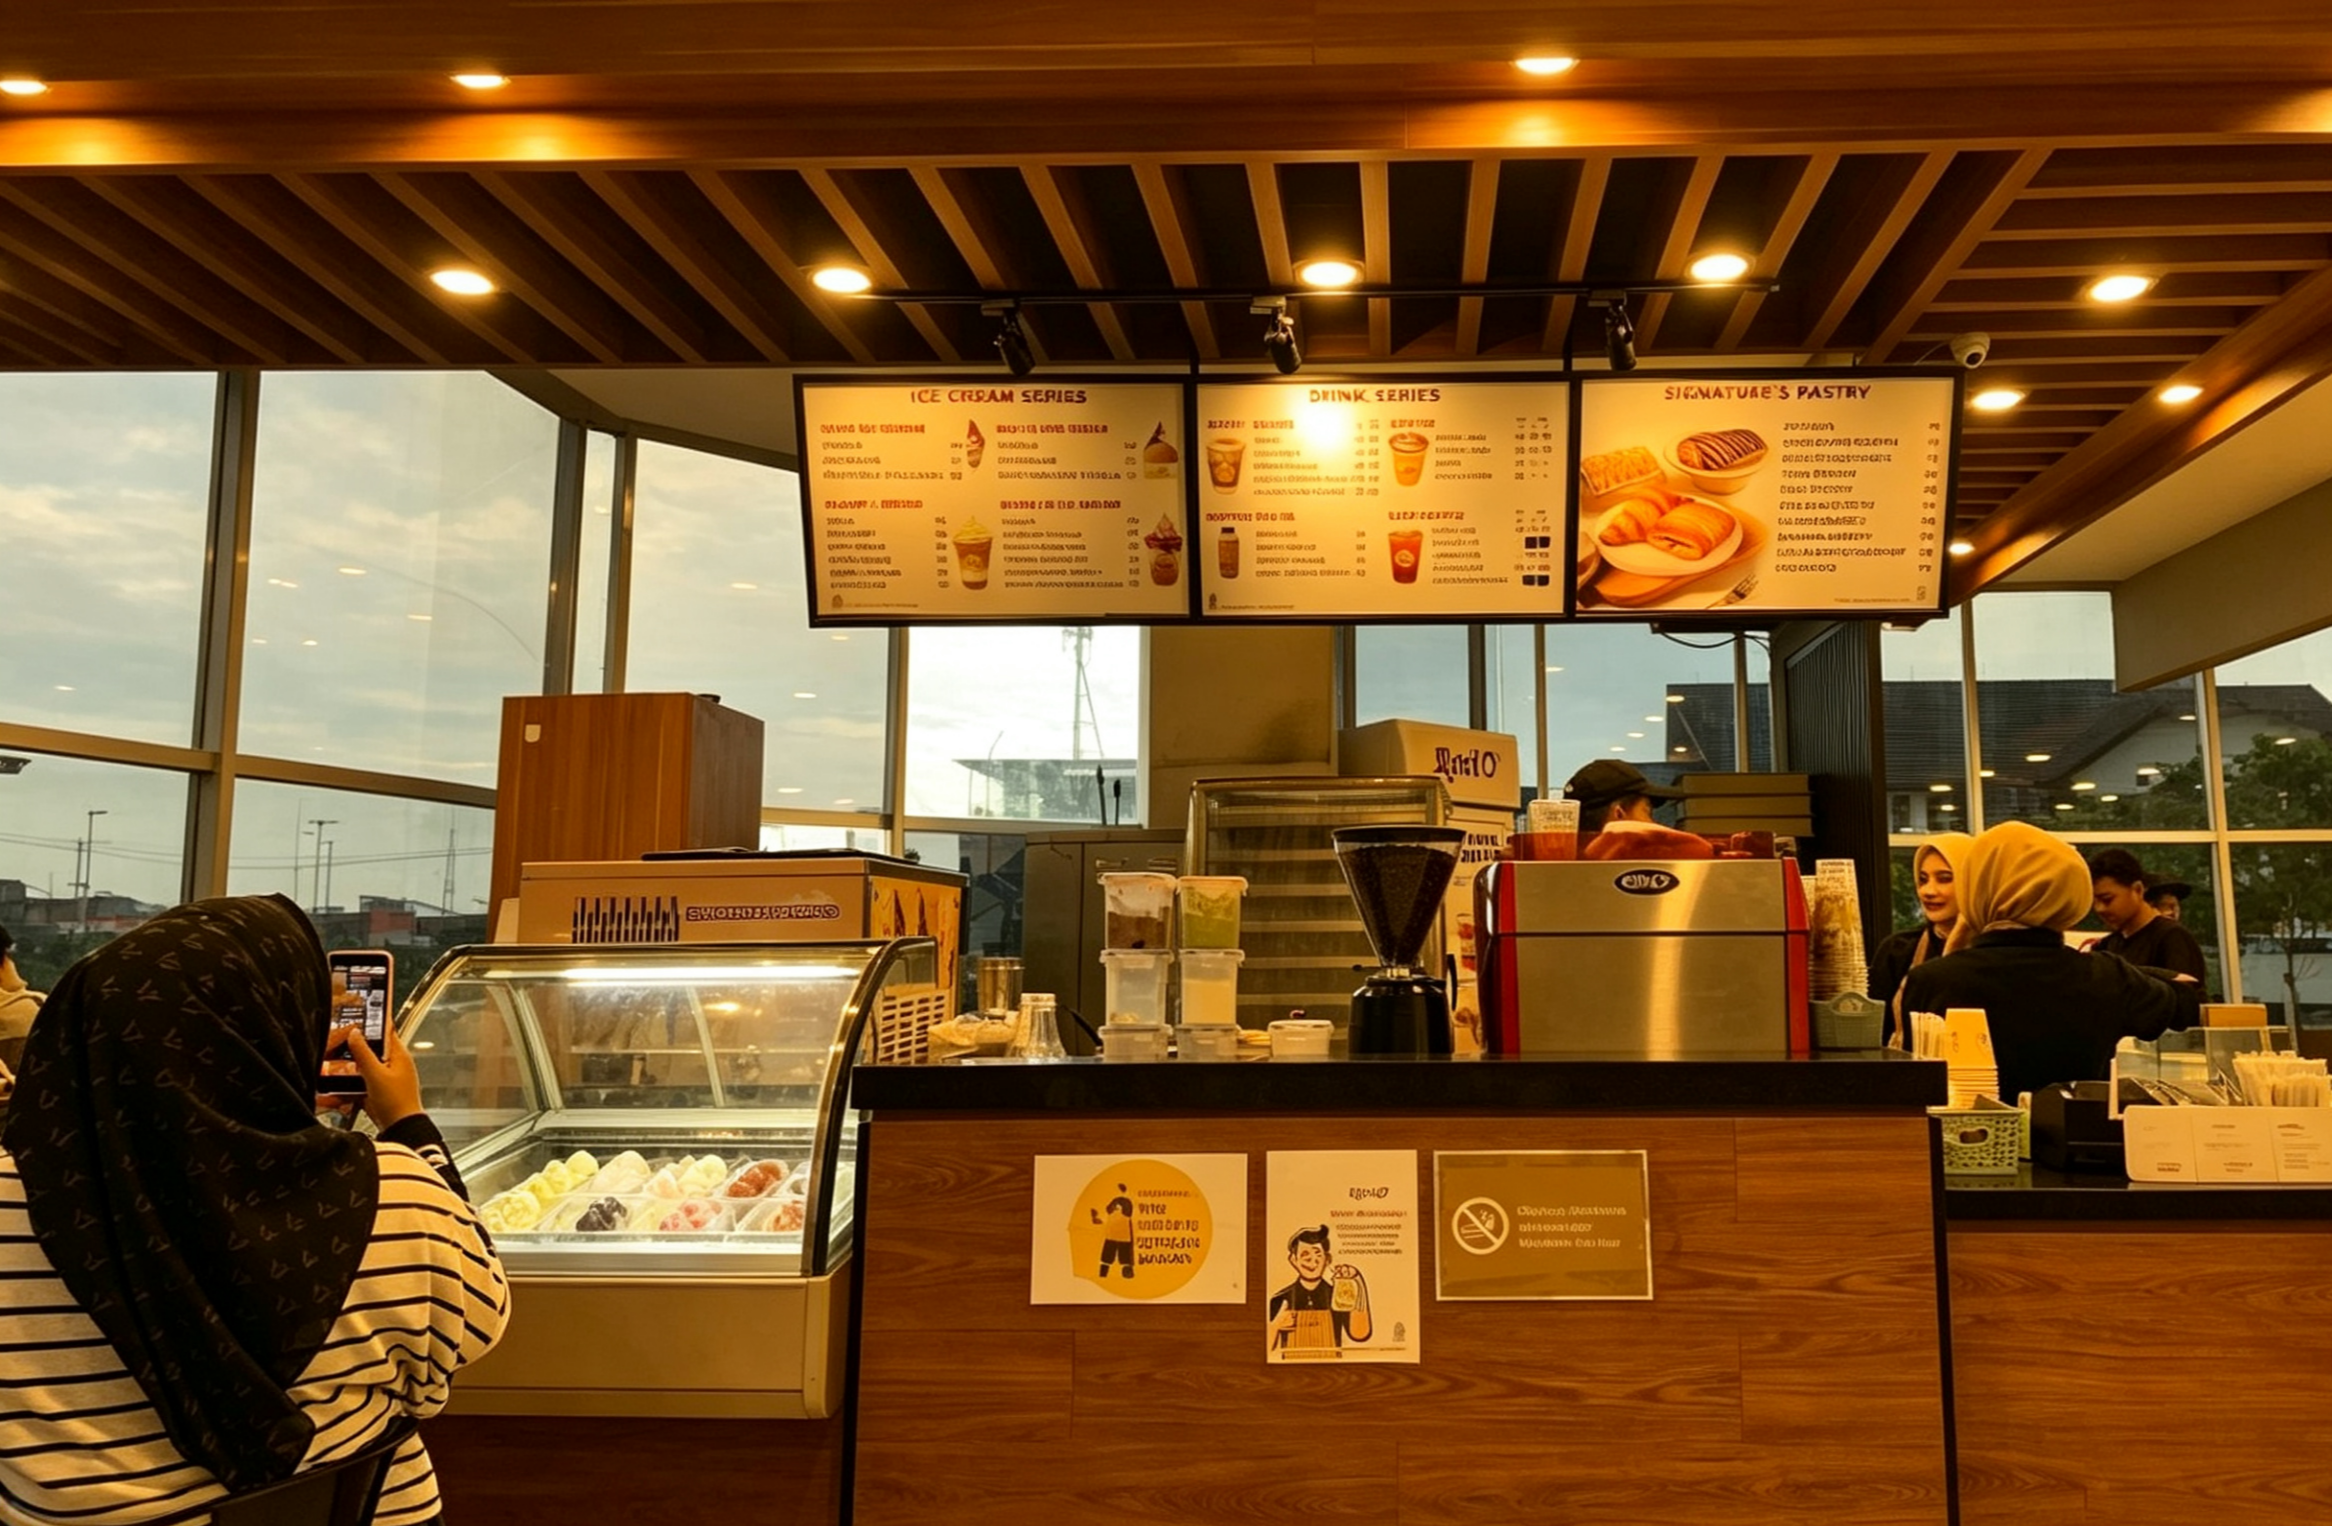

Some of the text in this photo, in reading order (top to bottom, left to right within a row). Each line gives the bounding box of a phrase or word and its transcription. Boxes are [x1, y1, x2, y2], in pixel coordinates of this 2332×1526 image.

[911, 389, 1088, 404] ICE CREAM SERIES
[1375, 388, 1442, 402] SERIES
[1796, 385, 1871, 400] PASTRY
